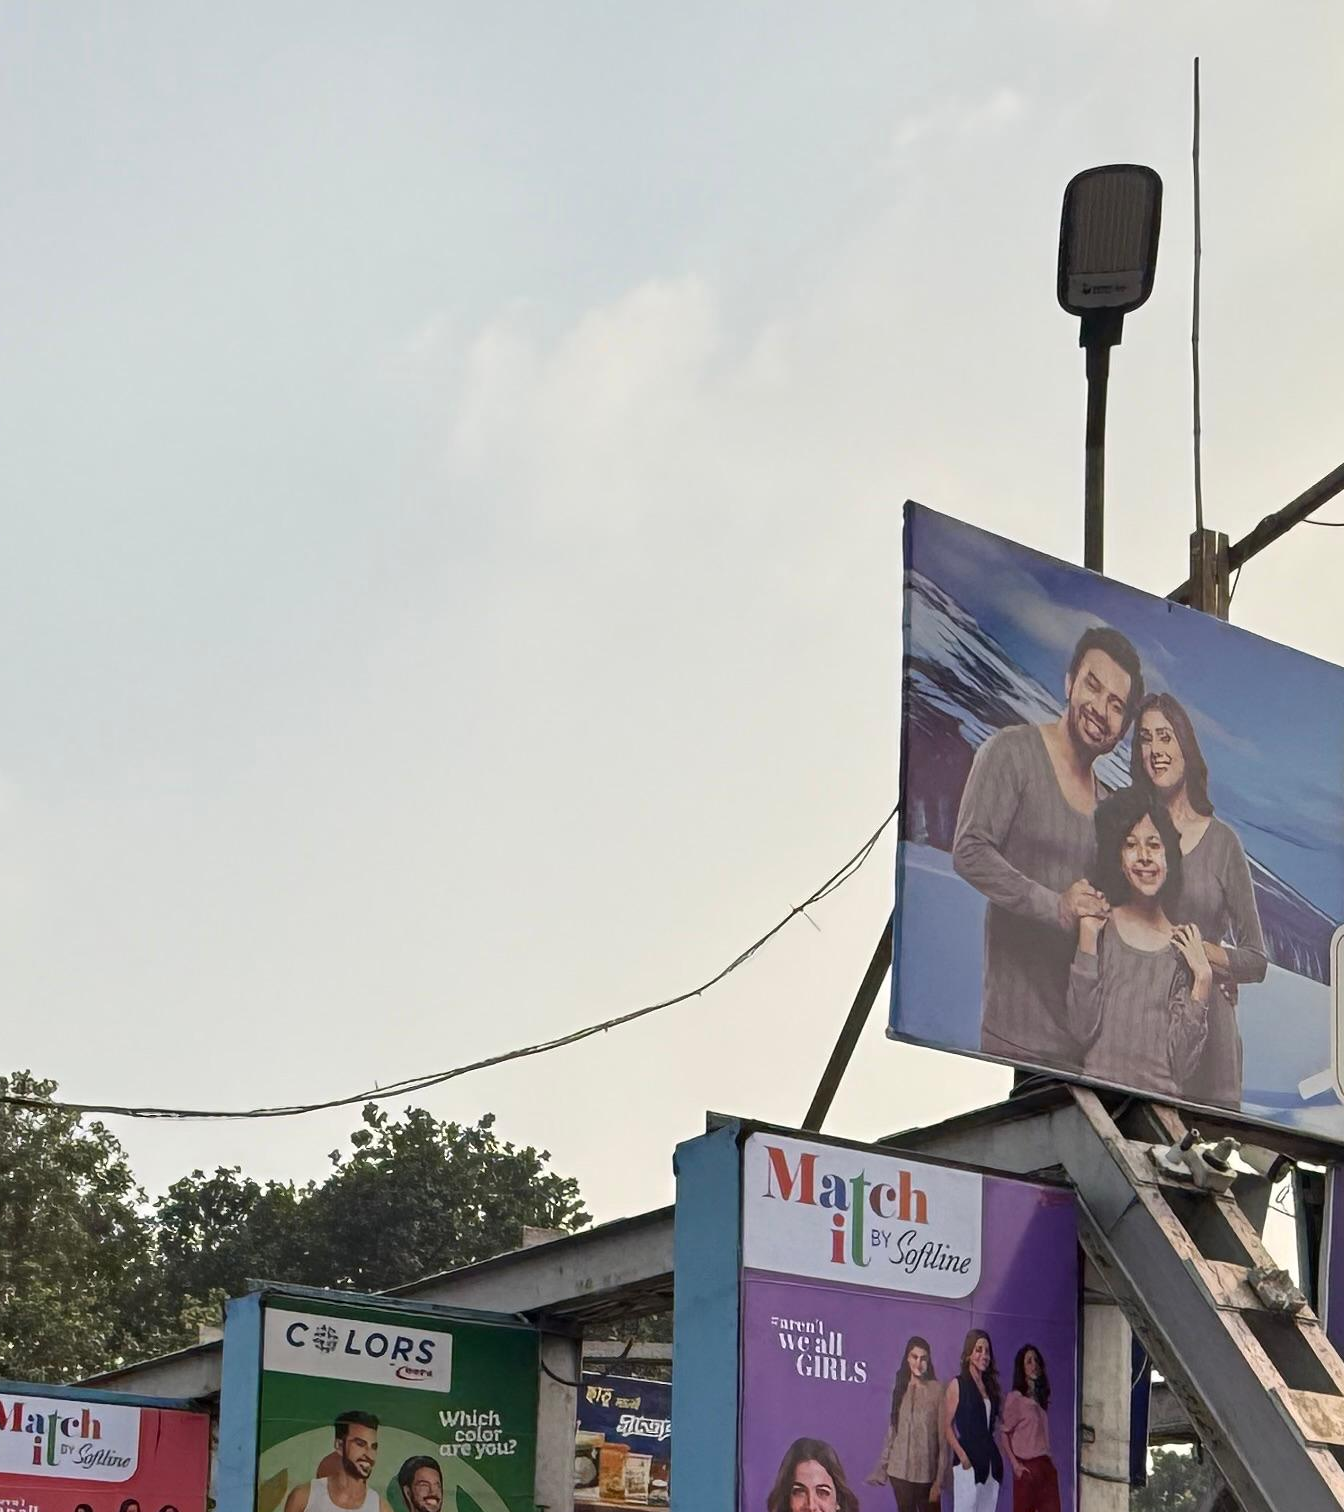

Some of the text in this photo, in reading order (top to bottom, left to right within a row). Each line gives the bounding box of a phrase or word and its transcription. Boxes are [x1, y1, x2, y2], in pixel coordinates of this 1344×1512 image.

[762, 1145, 929, 1226] Match
[830, 1211, 972, 1274] it BY Softline
[778, 1331, 843, 1356] we all
[796, 1352, 868, 1384] GIRLS
[439, 1409, 501, 1429] Which
[455, 1425, 503, 1443] color
[32, 1435, 59, 1467] it
[72, 1443, 131, 1470] Softline
[439, 1439, 518, 1460] are you?
